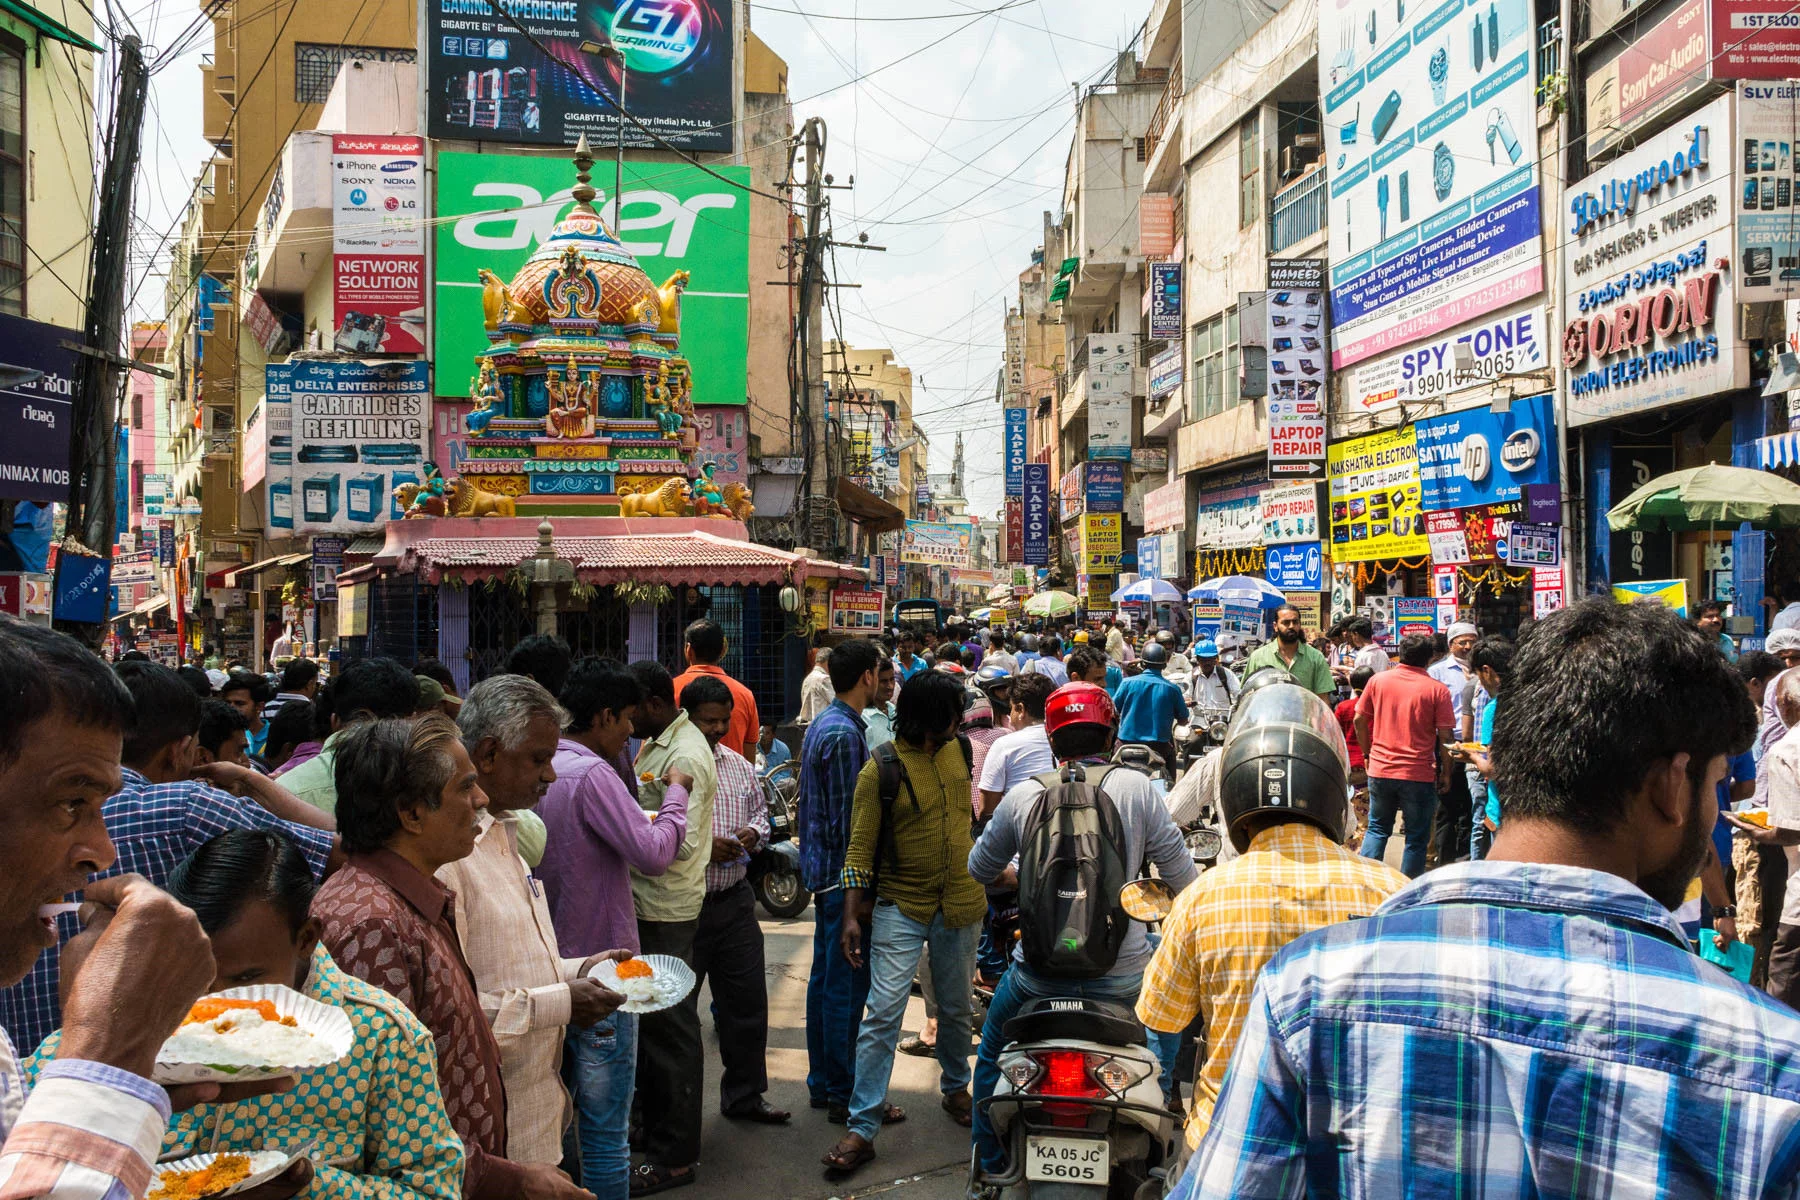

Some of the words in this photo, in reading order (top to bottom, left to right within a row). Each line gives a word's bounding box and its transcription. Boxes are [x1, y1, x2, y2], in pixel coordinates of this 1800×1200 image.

[1677, 3, 1701, 29] SONY
[1742, 16, 1763, 26] 1ST
[441, 20, 480, 31] GIGABYTE
[528, 26, 580, 37] Motherboards
[614, 34, 688, 53] GAMING
[1729, 54, 1744, 63] Web
[1622, 74, 1648, 109] Sony
[1649, 60, 1669, 88] Car
[1669, 33, 1704, 76] Audio
[1744, 87, 1773, 99] SLV
[564, 112, 605, 123] GIGABYTE
[654, 117, 679, 127] (India)
[681, 118, 696, 127] Pvt.
[698, 118, 713, 127] Ltd.
[346, 162, 377, 170] iPhone
[1571, 125, 1702, 235] Hollywood
[402, 200, 416, 209] LG
[454, 182, 736, 258] acer
[1336, 281, 1358, 299] Dealers
[1377, 263, 1395, 283] Types
[1405, 251, 1418, 268] Spy
[1420, 235, 1455, 258] Cameras,
[1456, 220, 1486, 242] Hidden
[1487, 197, 1529, 225] Cameras,
[1574, 254, 1592, 275] CAR
[1594, 228, 1645, 267] SPEAKERS
[338, 260, 419, 273] NETWORK
[1352, 286, 1364, 304] Spy
[1365, 283, 1382, 298] Voice
[1383, 269, 1417, 293] Recorders
[1422, 257, 1439, 271] Live
[1439, 240, 1476, 266] Listening
[1477, 224, 1506, 245] Device
[338, 276, 418, 289] SOLUTION
[1271, 269, 1321, 280] HAMEED
[1363, 297, 1379, 312] Stun
[1379, 291, 1397, 307] Guns
[1398, 286, 1404, 296] &
[1406, 274, 1431, 293] Mobile
[1432, 264, 1456, 286] Signal
[1457, 246, 1490, 268] Jammer
[1154, 270, 1164, 315] LAPTOP
[1372, 335, 1385, 347] +91
[1445, 304, 1460, 318] +91
[1588, 273, 1717, 360] ORION
[1402, 342, 1448, 379] SPY
[1457, 314, 1533, 357] ONE
[1571, 366, 1609, 395] ORION
[1612, 334, 1718, 384] ELECTRONICS
[295, 380, 334, 391] DELTA
[337, 380, 425, 391] ENTERPRISES
[302, 394, 421, 416] CARTRIDGES
[1366, 395, 1379, 403] 3rd
[302, 418, 421, 440] REFILLING
[1271, 426, 1324, 440] LAPTOP
[1010, 425, 1025, 473] LAPTOP
[1273, 442, 1322, 455] REPAIR
[1419, 442, 1463, 464] SATYAM
[1504, 439, 1530, 460] intel
[1331, 454, 1374, 476] NAKSHATRA
[1376, 444, 1417, 467] ELECTRON
[0, 464, 39, 483] NMAX
[1360, 475, 1374, 487] JVC
[1262, 503, 1287, 518] LAPTOP
[1290, 500, 1315, 515] REPAIR
[1488, 504, 1510, 516] Diwali
[1532, 498, 1557, 508] logitech
[1029, 485, 1042, 540] LAPTOP
[1397, 600, 1435, 608] SATYAM
[1065, 703, 1085, 713] NXT
[1050, 1001, 1083, 1011] YAMAHA
[1036, 1146, 1057, 1160] KA
[1061, 1148, 1077, 1161] 05
[1081, 1149, 1100, 1162] JC
[1041, 1164, 1095, 1179] 5605
